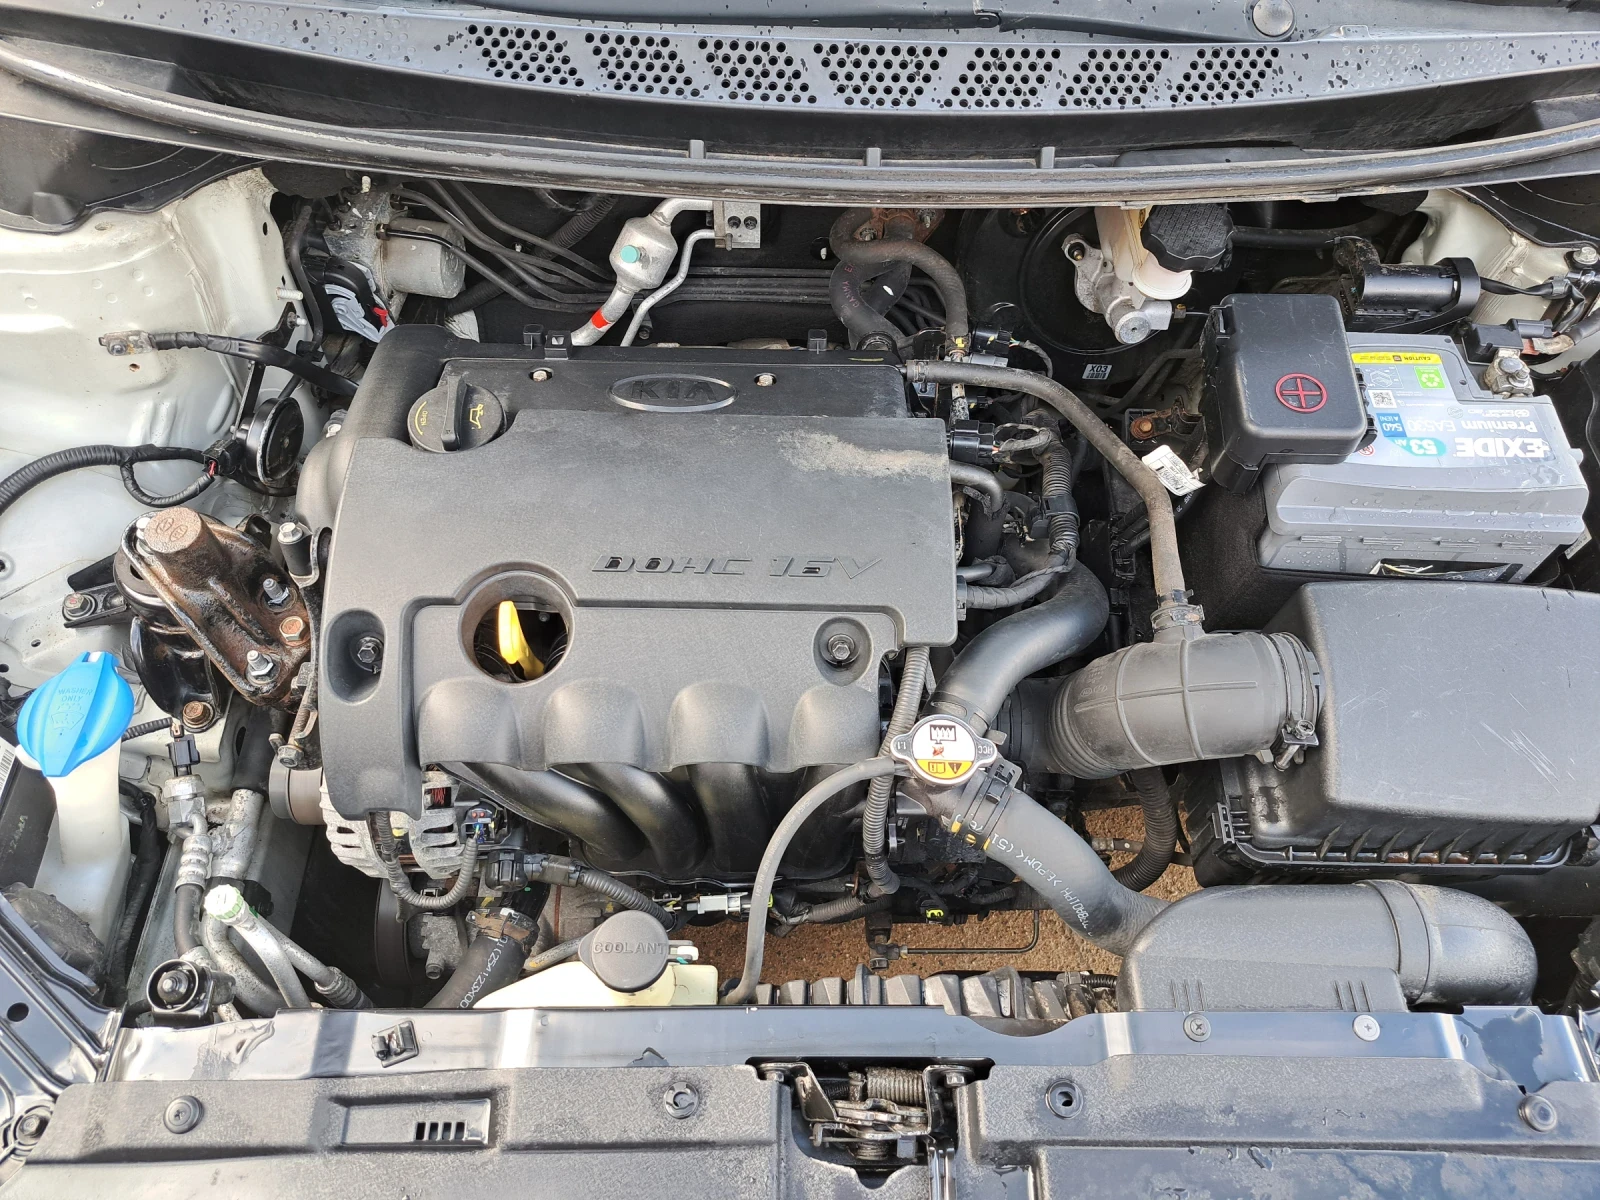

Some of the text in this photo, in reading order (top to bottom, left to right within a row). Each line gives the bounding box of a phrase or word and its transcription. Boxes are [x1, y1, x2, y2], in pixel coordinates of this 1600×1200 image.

[1088, 364, 1109, 373] X03
[630, 380, 719, 402] KIA
[420, 410, 428, 426] OPEN
[1383, 422, 1403, 433] 540
[1408, 419, 1538, 433] Premium EA530
[1410, 438, 1438, 455] 53
[1454, 437, 1549, 458] EXIDE
[591, 555, 883, 579] DOHC 16V
[59, 687, 93, 696] WASHER
[897, 741, 907, 750] 1.1
[977, 745, 993, 754] HCC
[593, 941, 668, 955] COOLANT
